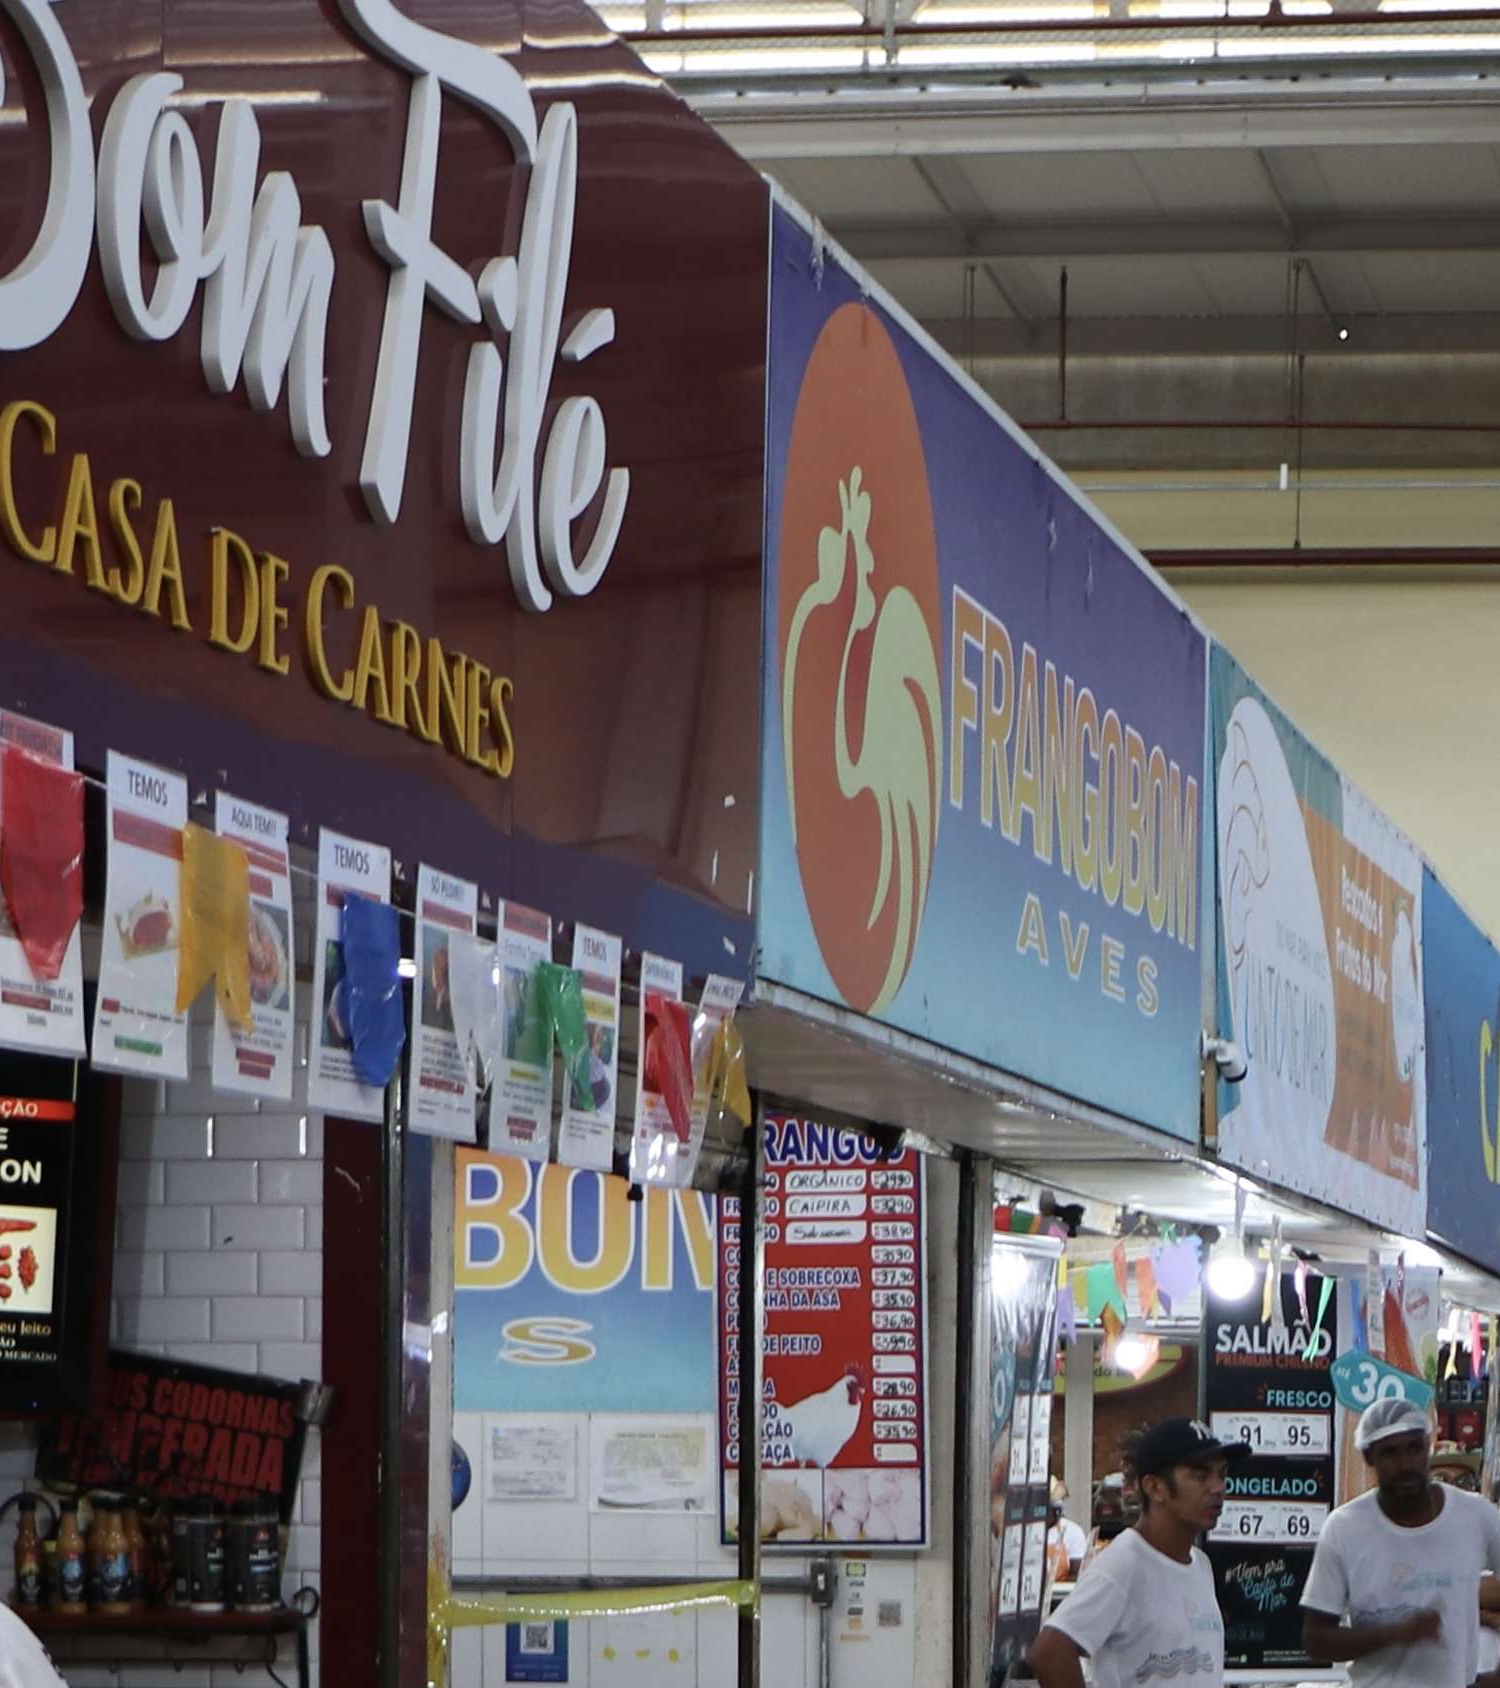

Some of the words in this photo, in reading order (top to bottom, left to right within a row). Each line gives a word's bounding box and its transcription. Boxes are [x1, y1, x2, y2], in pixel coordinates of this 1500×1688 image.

[208, 526, 290, 676] DE
[308, 566, 514, 780] CARNES
[951, 581, 1200, 951] FRANGOBOM
[128, 769, 168, 807] TEMOS
[231, 806, 251, 831] AQUI
[334, 843, 370, 876] TEMOS
[1017, 892, 1161, 1020] AVES
[763, 1118, 906, 1167] RANGO
[789, 1169, 864, 1189] ORGÂNICO
[789, 1198, 852, 1215] CAIPIRA
[778, 1268, 861, 1289] SOBRECOXA
[791, 1290, 811, 1309] DA
[811, 1290, 841, 1310] ASA
[496, 1315, 597, 1368] S
[779, 1335, 822, 1354] PEITO
[1215, 1320, 1333, 1358] SALMÃO
[154, 1376, 294, 1440] CODORNAS
[1266, 1389, 1332, 1408] FRESCO
[1239, 1424, 1263, 1447] 91
[1287, 1425, 1312, 1447] 95
[1238, 1514, 1263, 1537] 67
[1286, 1514, 1311, 1537] 69
